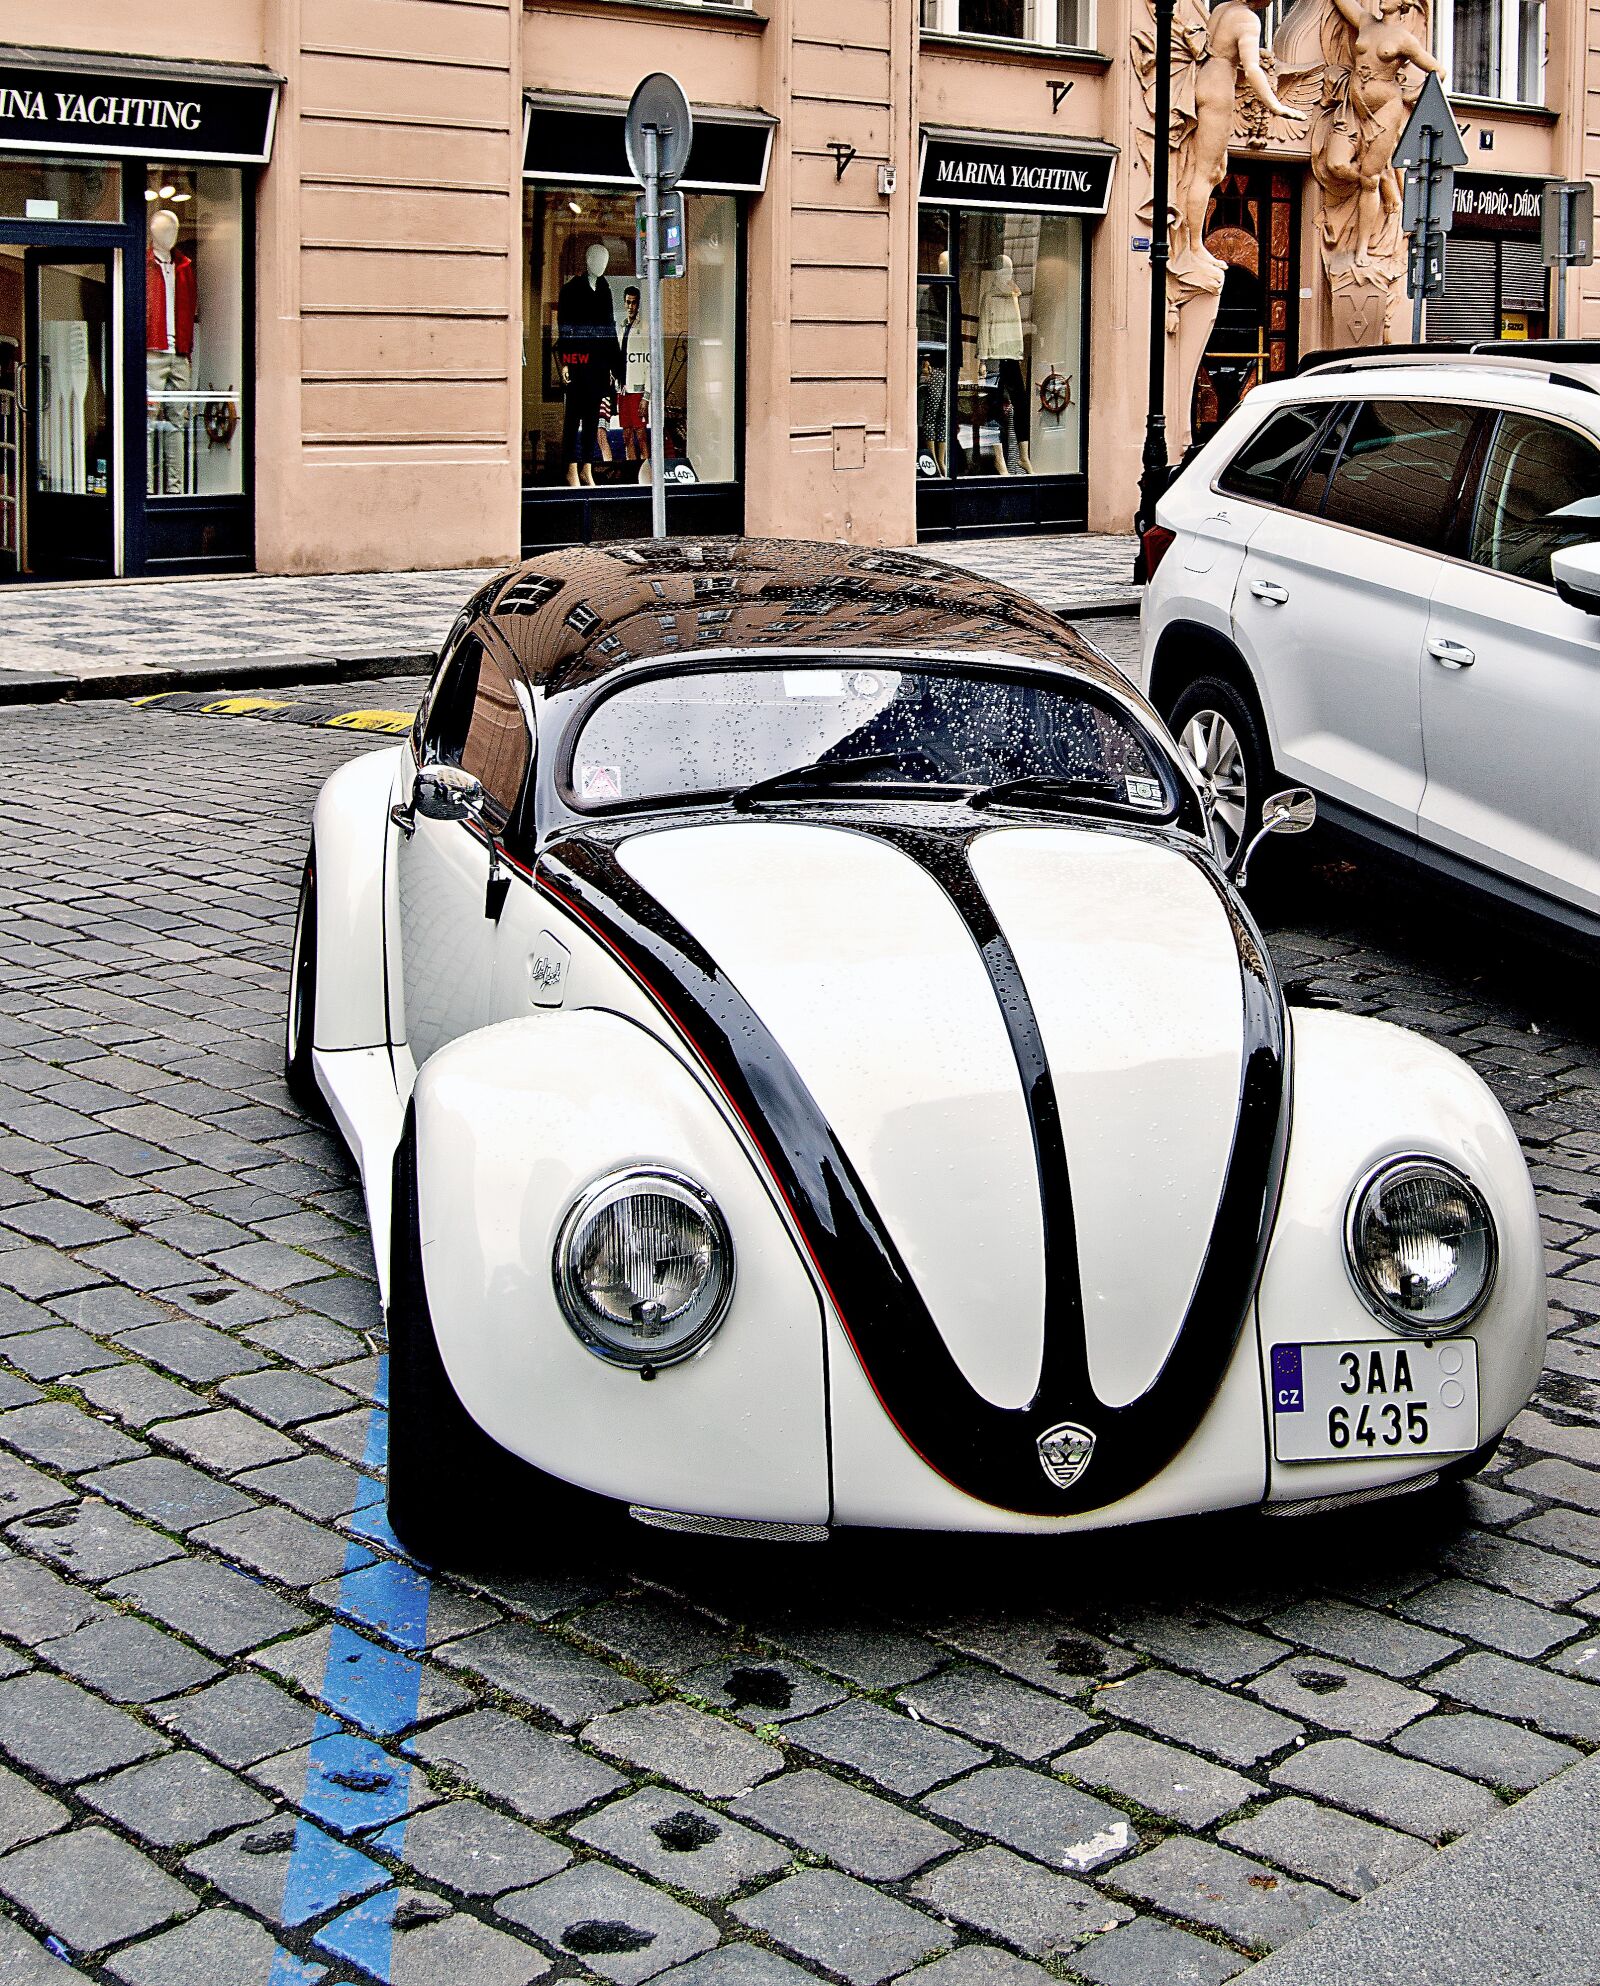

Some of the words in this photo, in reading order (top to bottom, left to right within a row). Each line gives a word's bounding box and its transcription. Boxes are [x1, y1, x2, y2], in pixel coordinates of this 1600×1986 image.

[54, 93, 202, 130] YACHTING
[936, 160, 1007, 186] MARINA
[1010, 165, 1093, 193] YACHTING
[562, 353, 590, 364] NEW
[1339, 1349, 1414, 1395] 3AA
[1278, 1389, 1300, 1406] CZ
[1327, 1401, 1430, 1450] 6435
